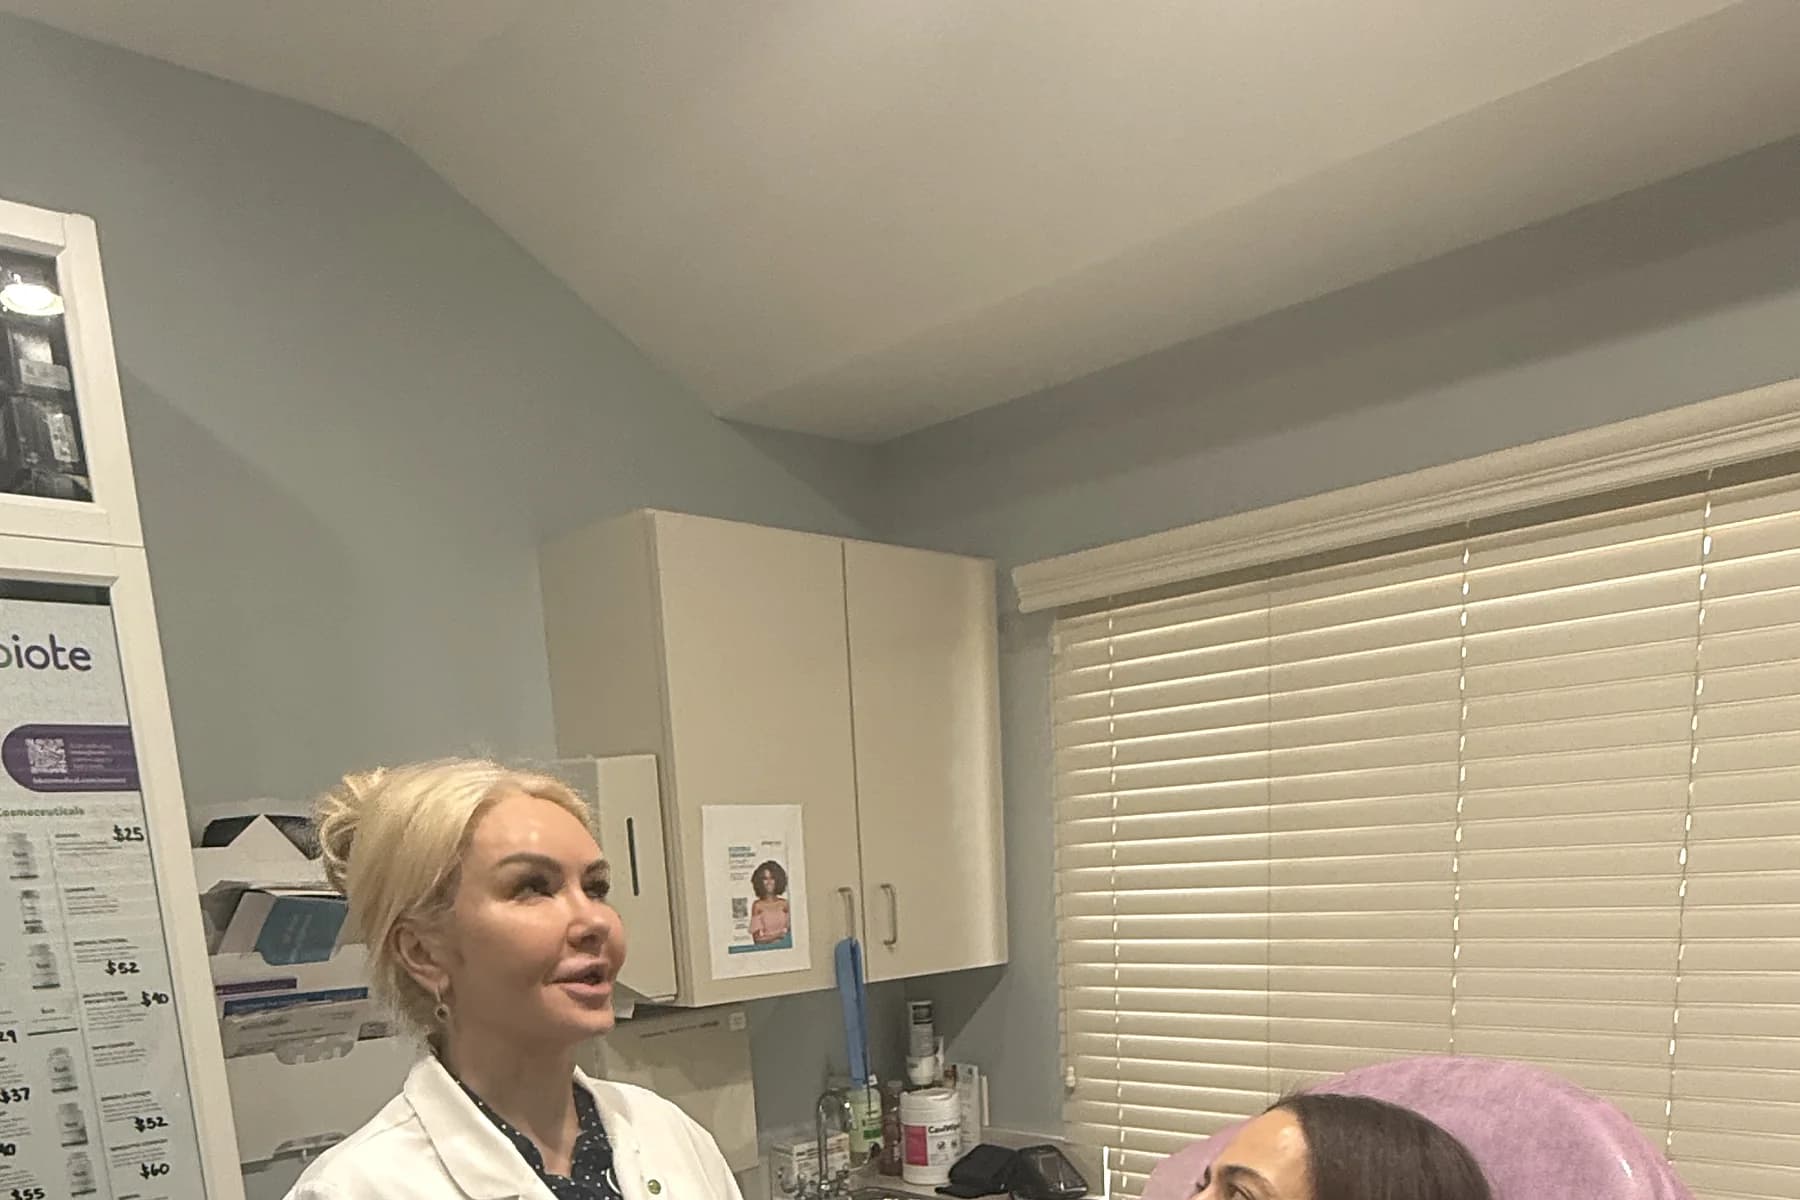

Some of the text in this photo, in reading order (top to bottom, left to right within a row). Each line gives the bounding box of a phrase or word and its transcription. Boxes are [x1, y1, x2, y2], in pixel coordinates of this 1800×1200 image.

[112, 824, 145, 843] $25
[104, 959, 140, 976] $52
[134, 1115, 169, 1133] $52
[140, 1162, 171, 1180] $60
